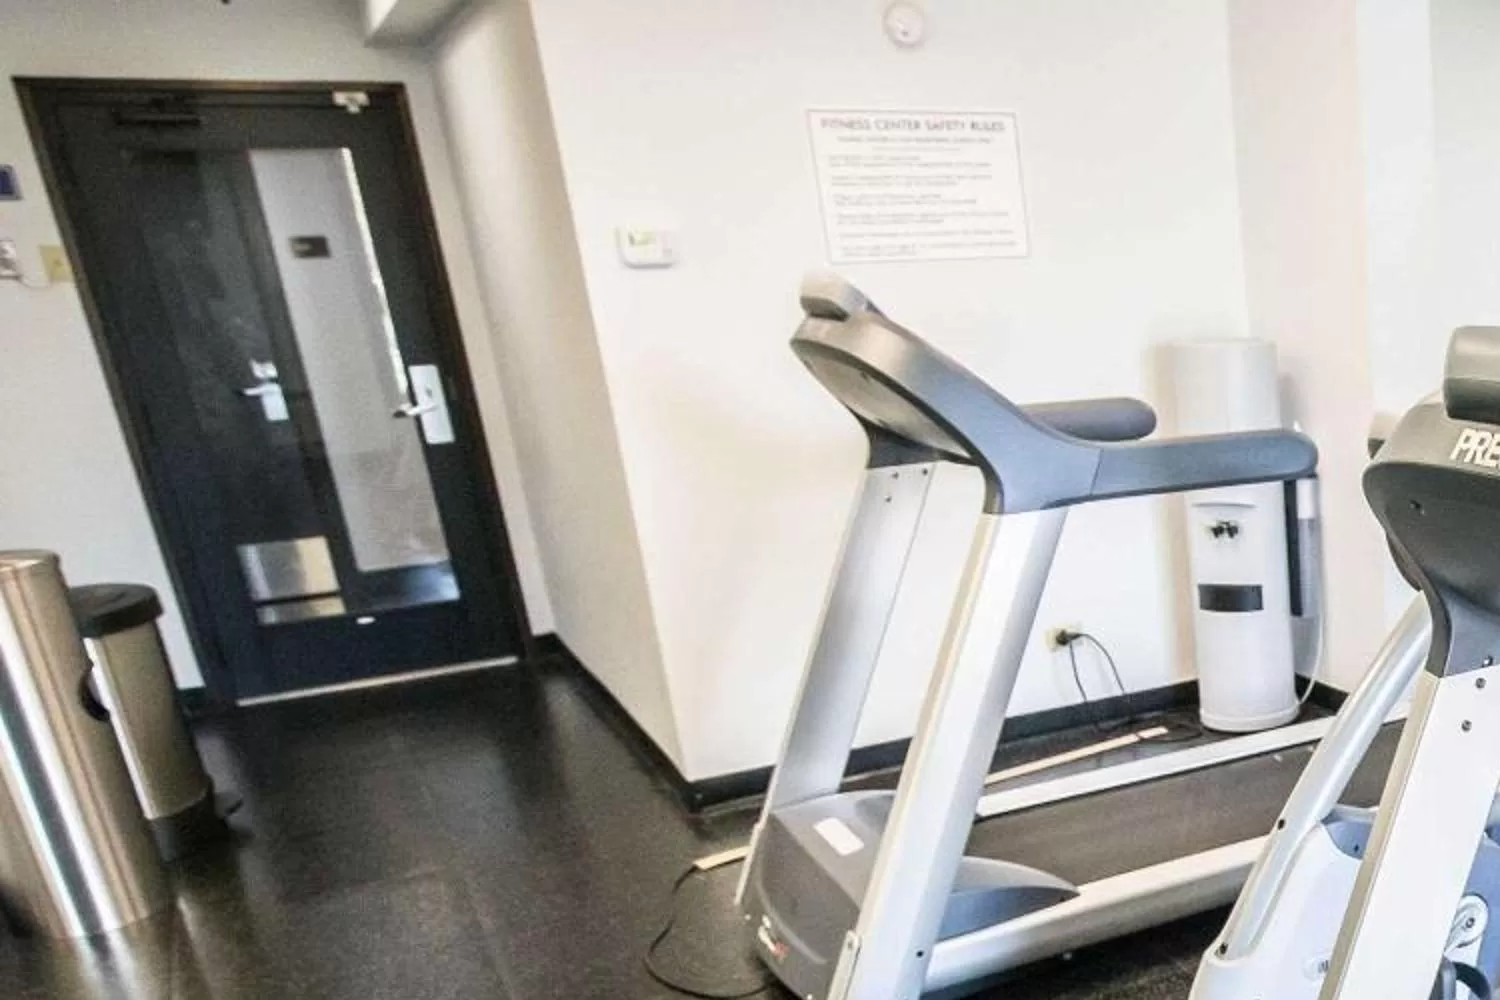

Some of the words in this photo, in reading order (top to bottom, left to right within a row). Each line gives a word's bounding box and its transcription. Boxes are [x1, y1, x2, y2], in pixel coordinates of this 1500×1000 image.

[820, 117, 871, 131] FITNESS
[874, 118, 921, 132] CENTER
[925, 119, 967, 132] SAFETY
[970, 119, 1006, 133] RULES
